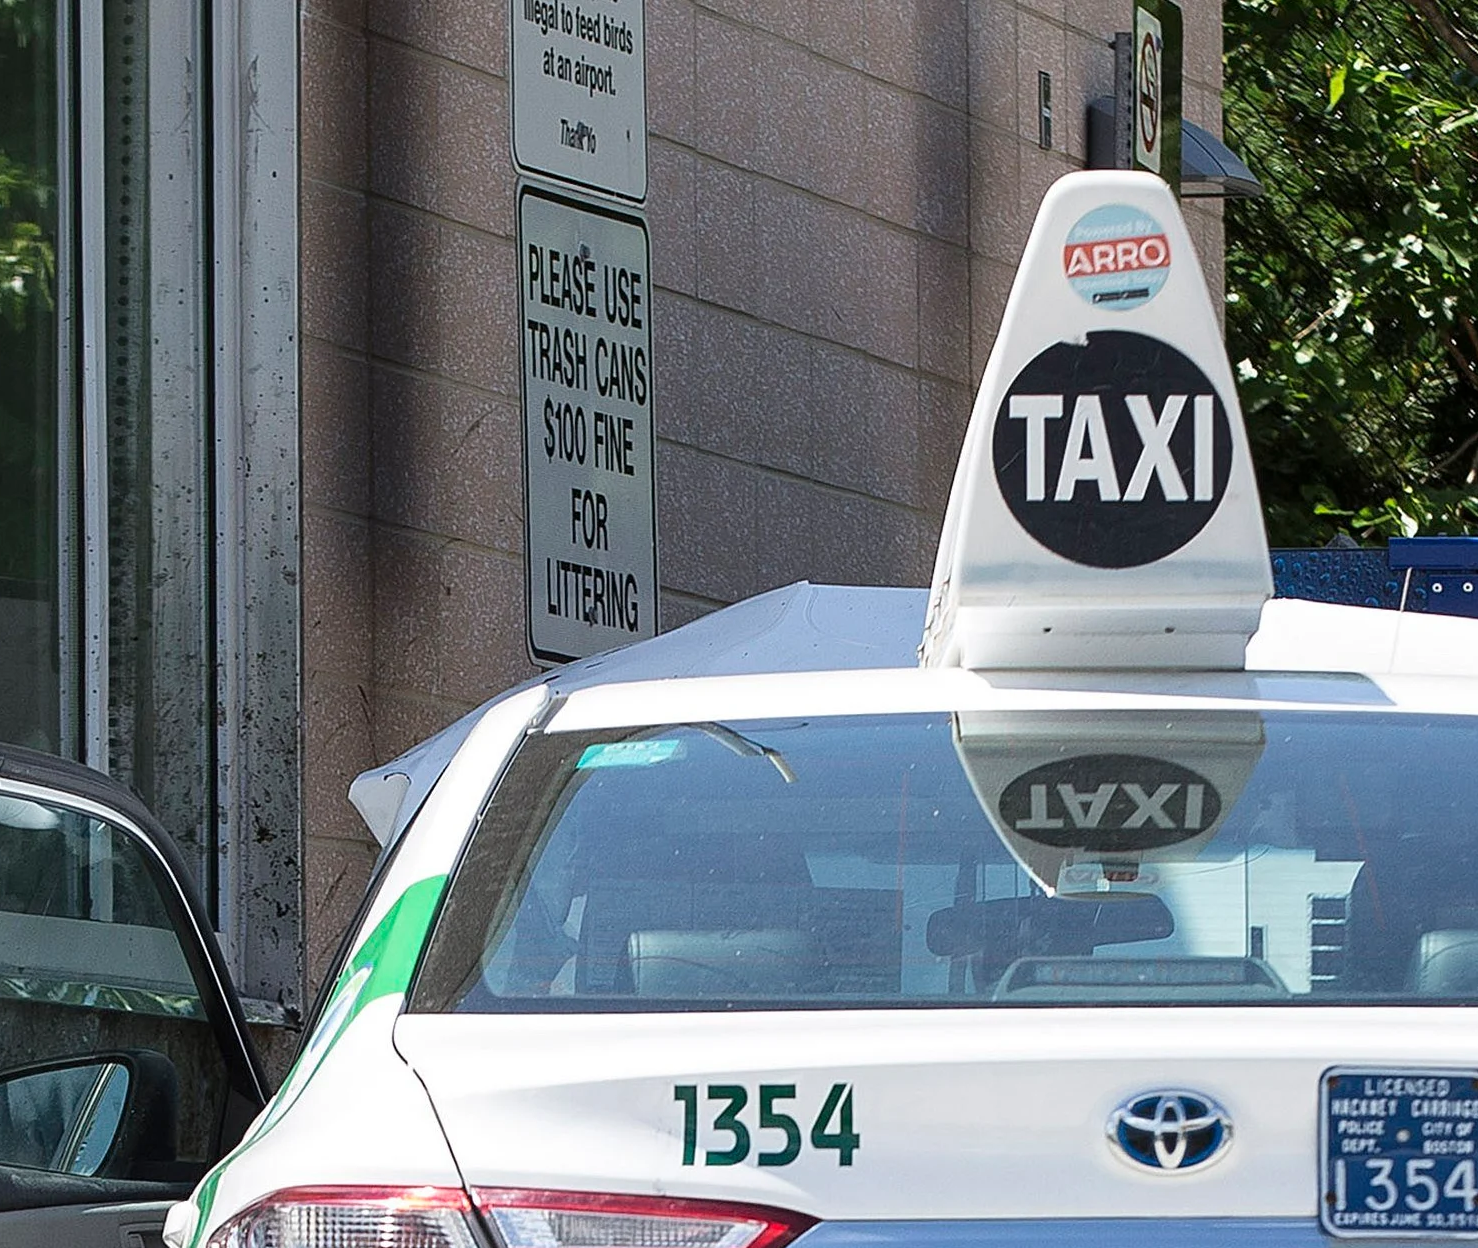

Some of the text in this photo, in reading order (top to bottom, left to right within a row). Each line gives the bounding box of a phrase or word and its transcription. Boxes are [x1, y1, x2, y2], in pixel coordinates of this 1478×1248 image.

[560, 3, 573, 35] to
[575, 6, 601, 44] feed
[603, 15, 633, 54] birds
[543, 47, 616, 97] at an airport.
[1068, 238, 1167, 276] ARRO
[528, 243, 643, 330] PLEASE USE
[527, 320, 647, 406] TRASH CANS
[543, 394, 635, 477] $100 FINE
[1008, 394, 1215, 502] TAXI
[571, 488, 609, 552] FOR
[546, 558, 639, 633] LITTERING
[1364, 1079, 1451, 1097] LICENSED
[674, 1083, 861, 1167] 1354
[1338, 1120, 1386, 1136] POLICE
[1423, 1140, 1475, 1155] BOSTON
[1455, 1122, 1475, 1137] OF
